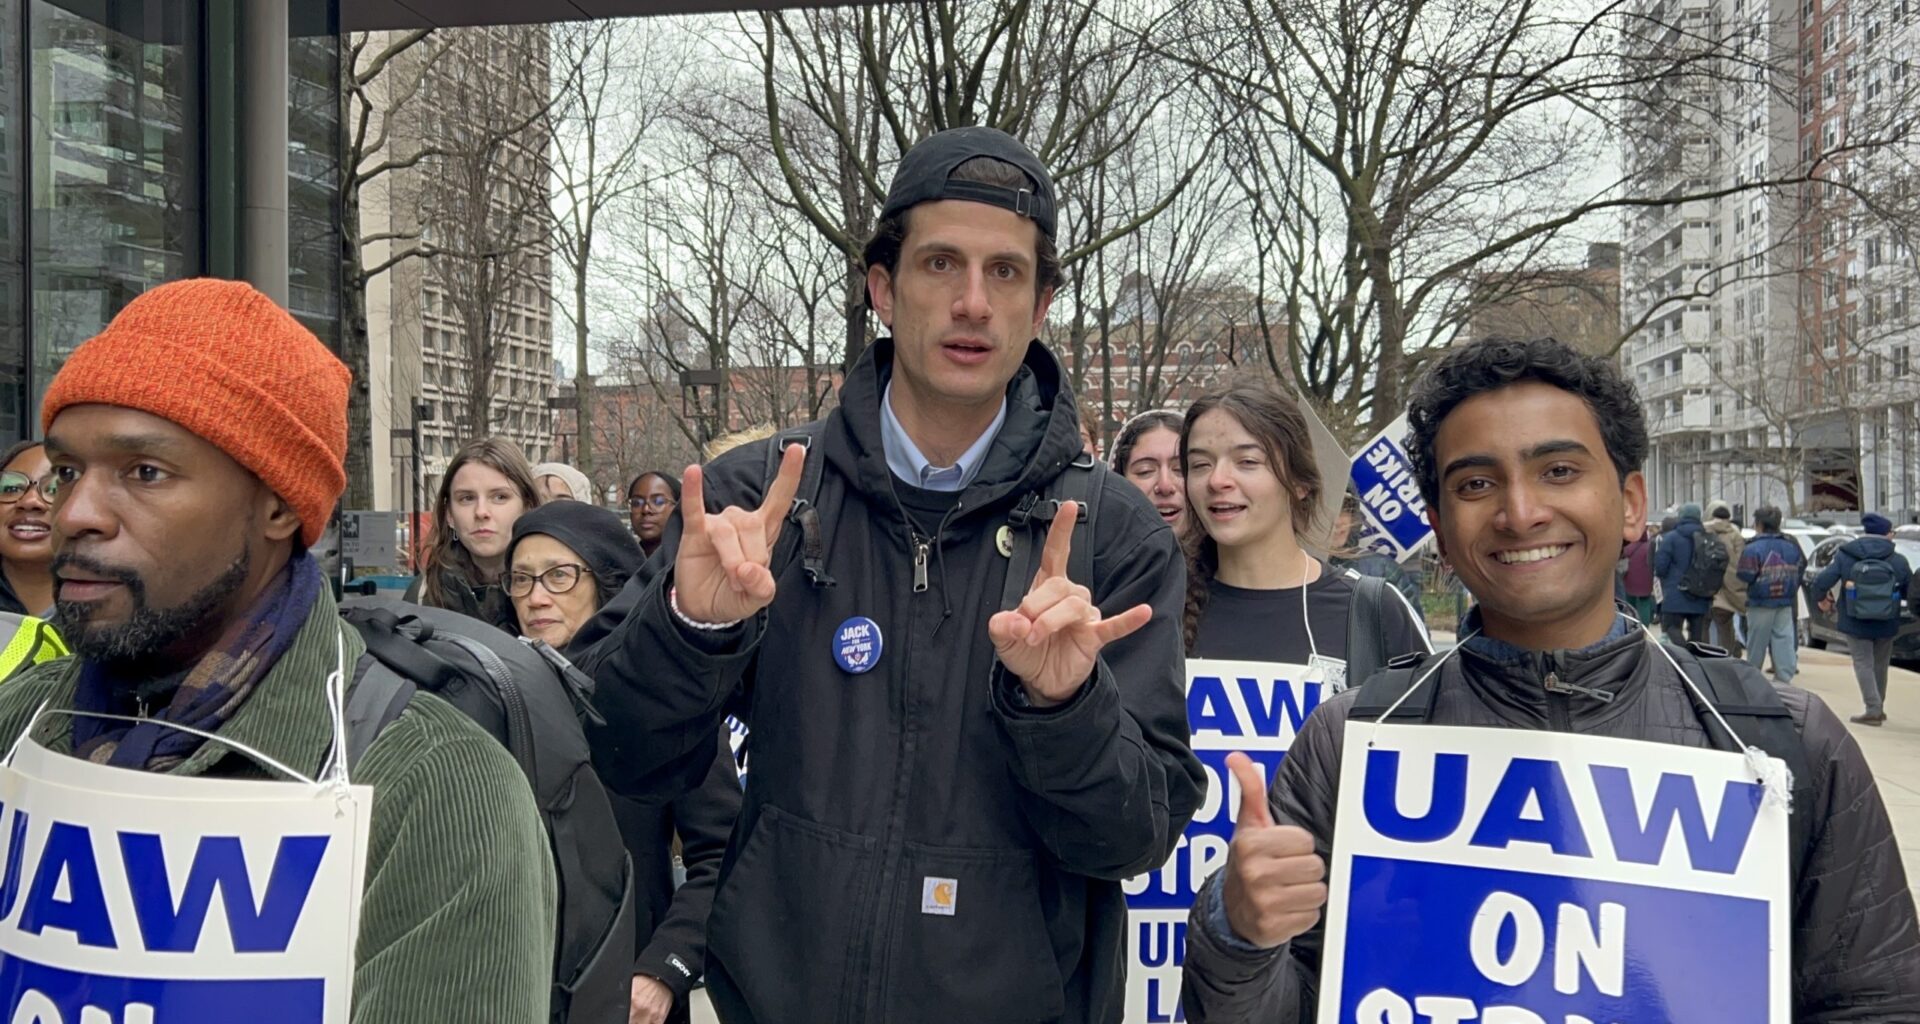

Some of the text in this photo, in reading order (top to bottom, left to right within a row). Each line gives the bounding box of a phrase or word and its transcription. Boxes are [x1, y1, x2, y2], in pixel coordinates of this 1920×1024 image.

[1363, 482, 1402, 522] ON
[841, 625, 870, 640] JACK
[1186, 676, 1323, 738] AW
[1363, 748, 1766, 876] UAW
[1469, 891, 1627, 998] ON
